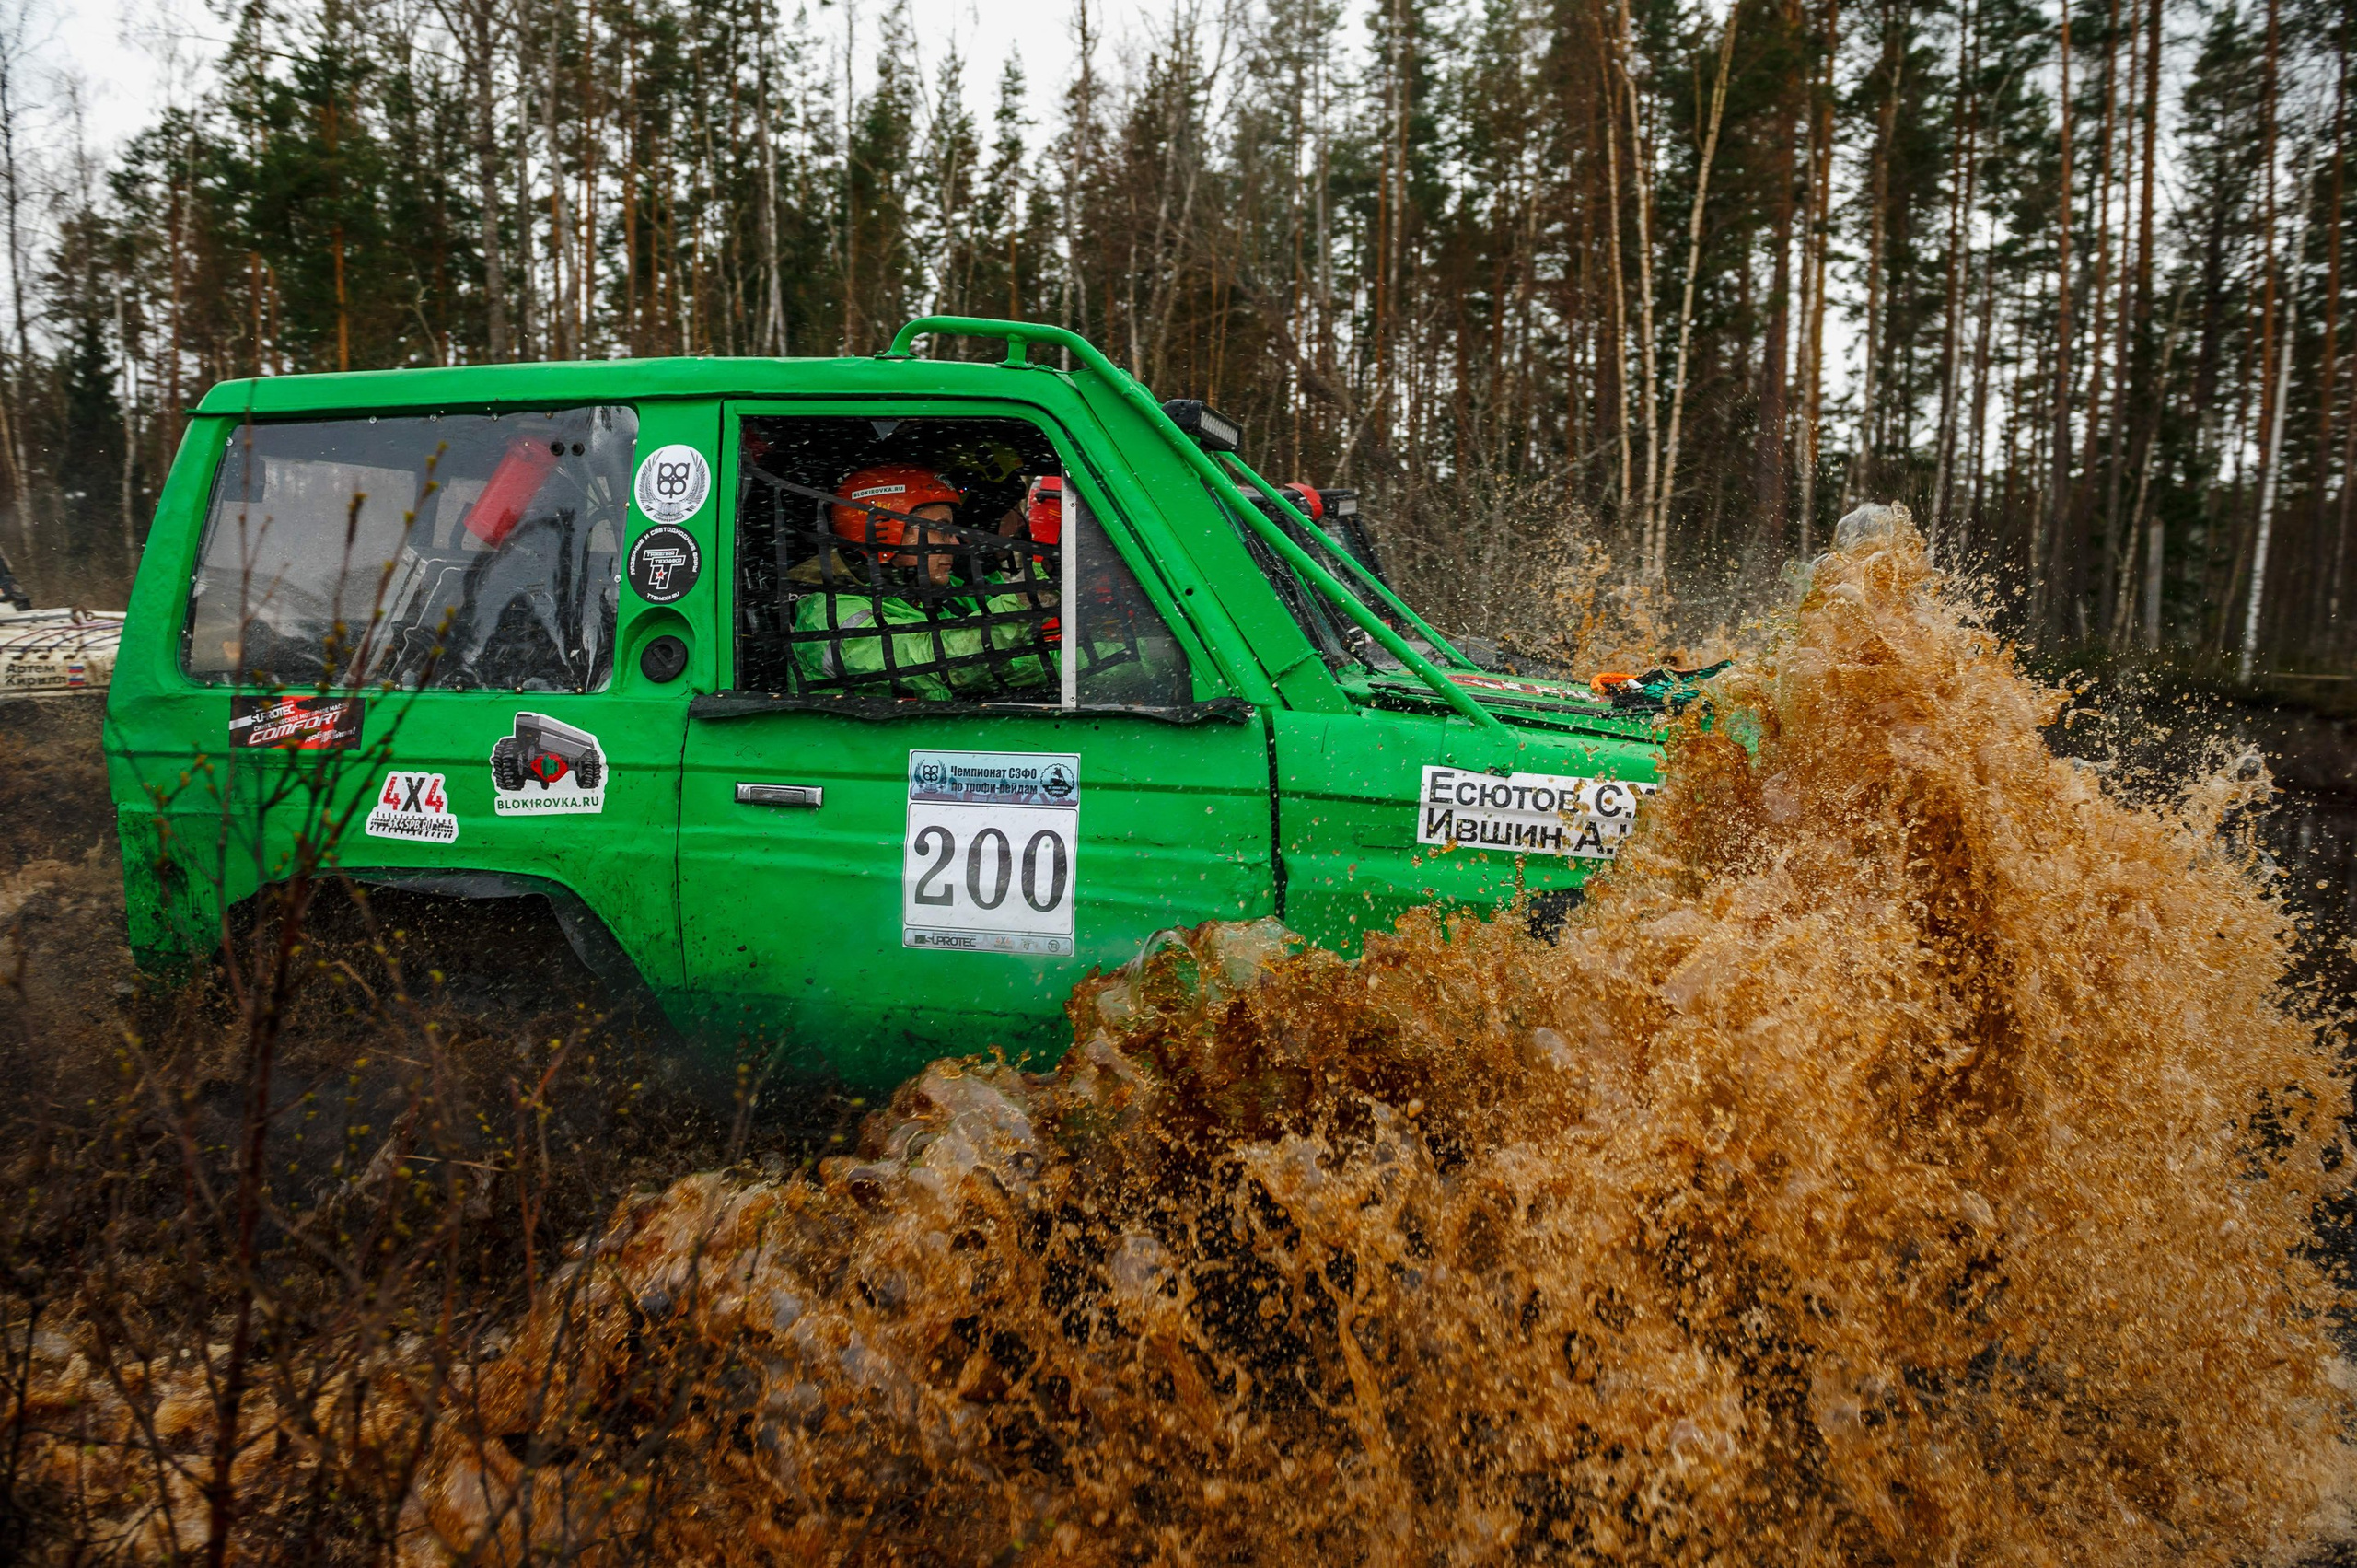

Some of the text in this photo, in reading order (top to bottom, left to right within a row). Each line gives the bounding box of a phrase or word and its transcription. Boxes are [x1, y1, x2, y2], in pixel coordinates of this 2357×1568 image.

[853, 485, 904, 498] BLOKIROVKA.RU
[249, 708, 348, 745] COMFORT
[253, 714, 299, 732] СИНТЕТЧЕСКОЕ
[950, 766, 1038, 780] Чемпионат СЗФО
[382, 776, 444, 813] 4X4
[951, 783, 963, 792] по
[965, 783, 1038, 795] трофи-рейдам
[1429, 771, 1581, 814] Есютов
[497, 796, 599, 809] BLOKIROVKA.RU
[1425, 807, 1564, 850] Ившин
[914, 825, 1068, 912] 200
[925, 935, 977, 947] SUPROTEC
